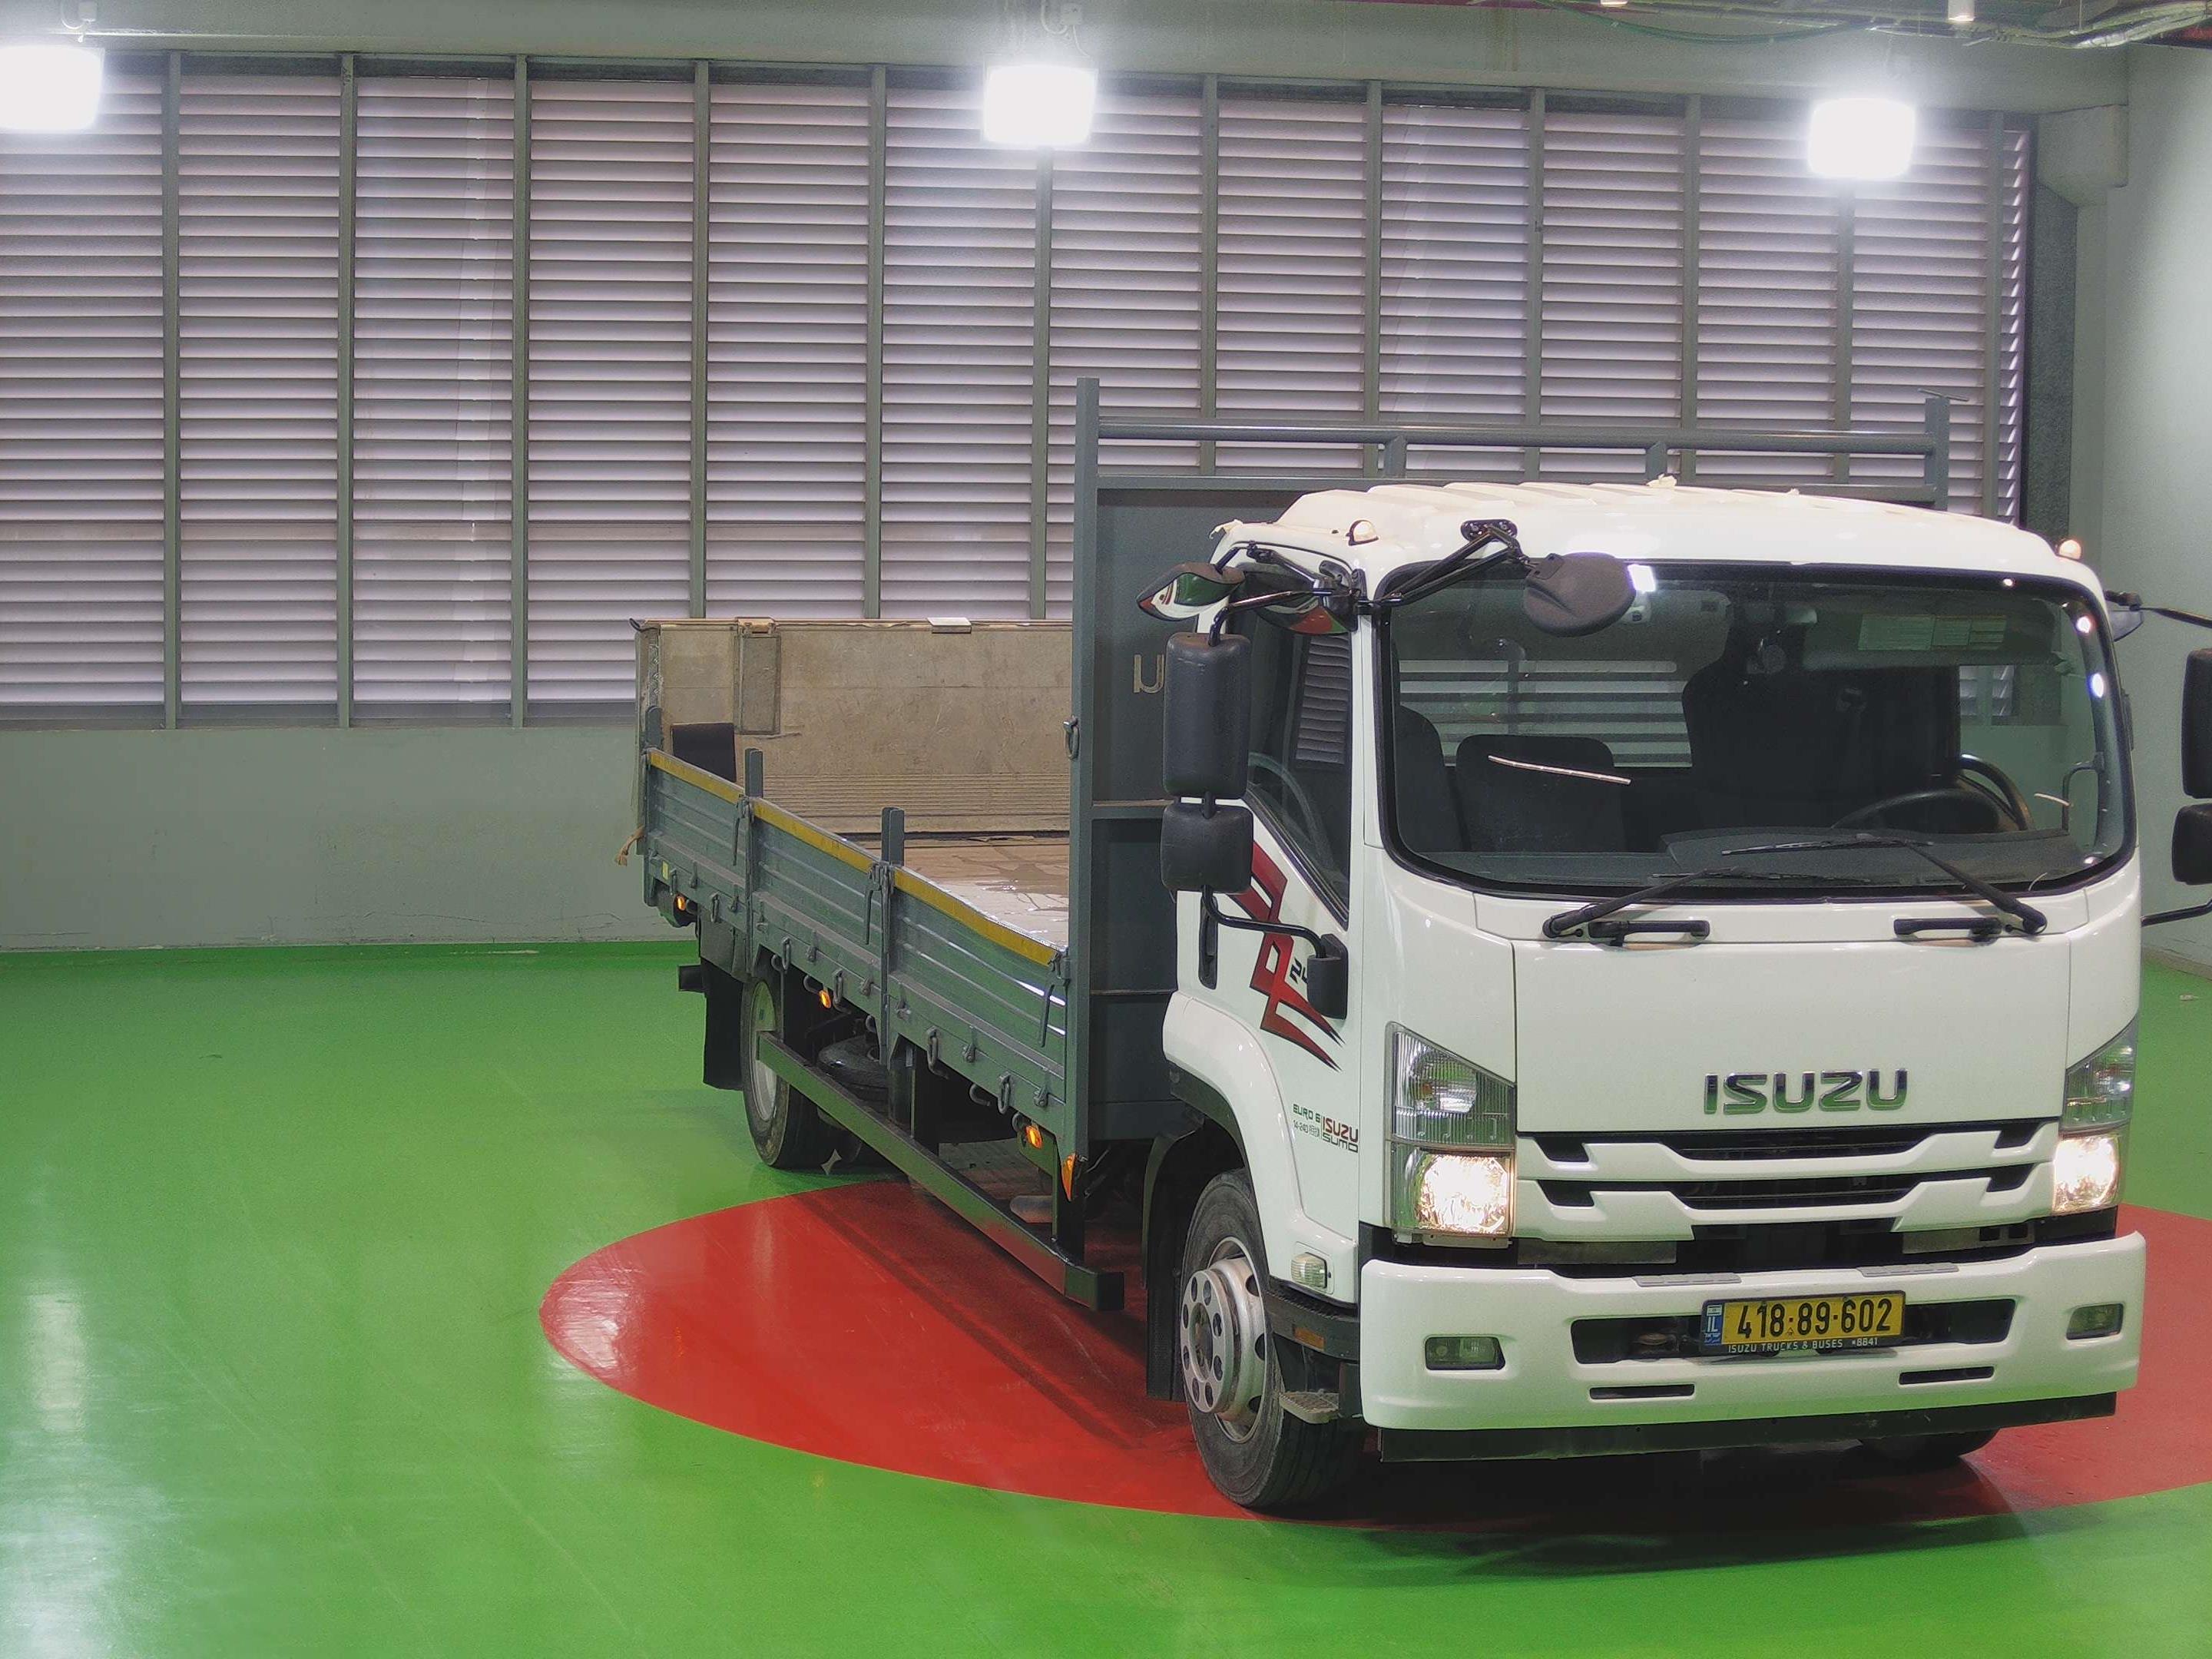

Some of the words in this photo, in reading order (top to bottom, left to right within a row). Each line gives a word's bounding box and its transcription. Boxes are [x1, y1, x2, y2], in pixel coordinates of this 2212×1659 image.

[1704, 1068, 1908, 1114] ISUZU
[1293, 1104, 1313, 1120] EURO
[1315, 1113, 1321, 1123] 6
[1323, 1116, 1359, 1143] ISUZU
[1322, 1132, 1359, 1153] SUMO
[1707, 1316, 1719, 1333] IL
[1728, 1344, 1757, 1353] ISUZU
[1761, 1342, 1798, 1352] TRUCKS
[1802, 1340, 1808, 1349] &
[1812, 1339, 1843, 1349] BUSES
